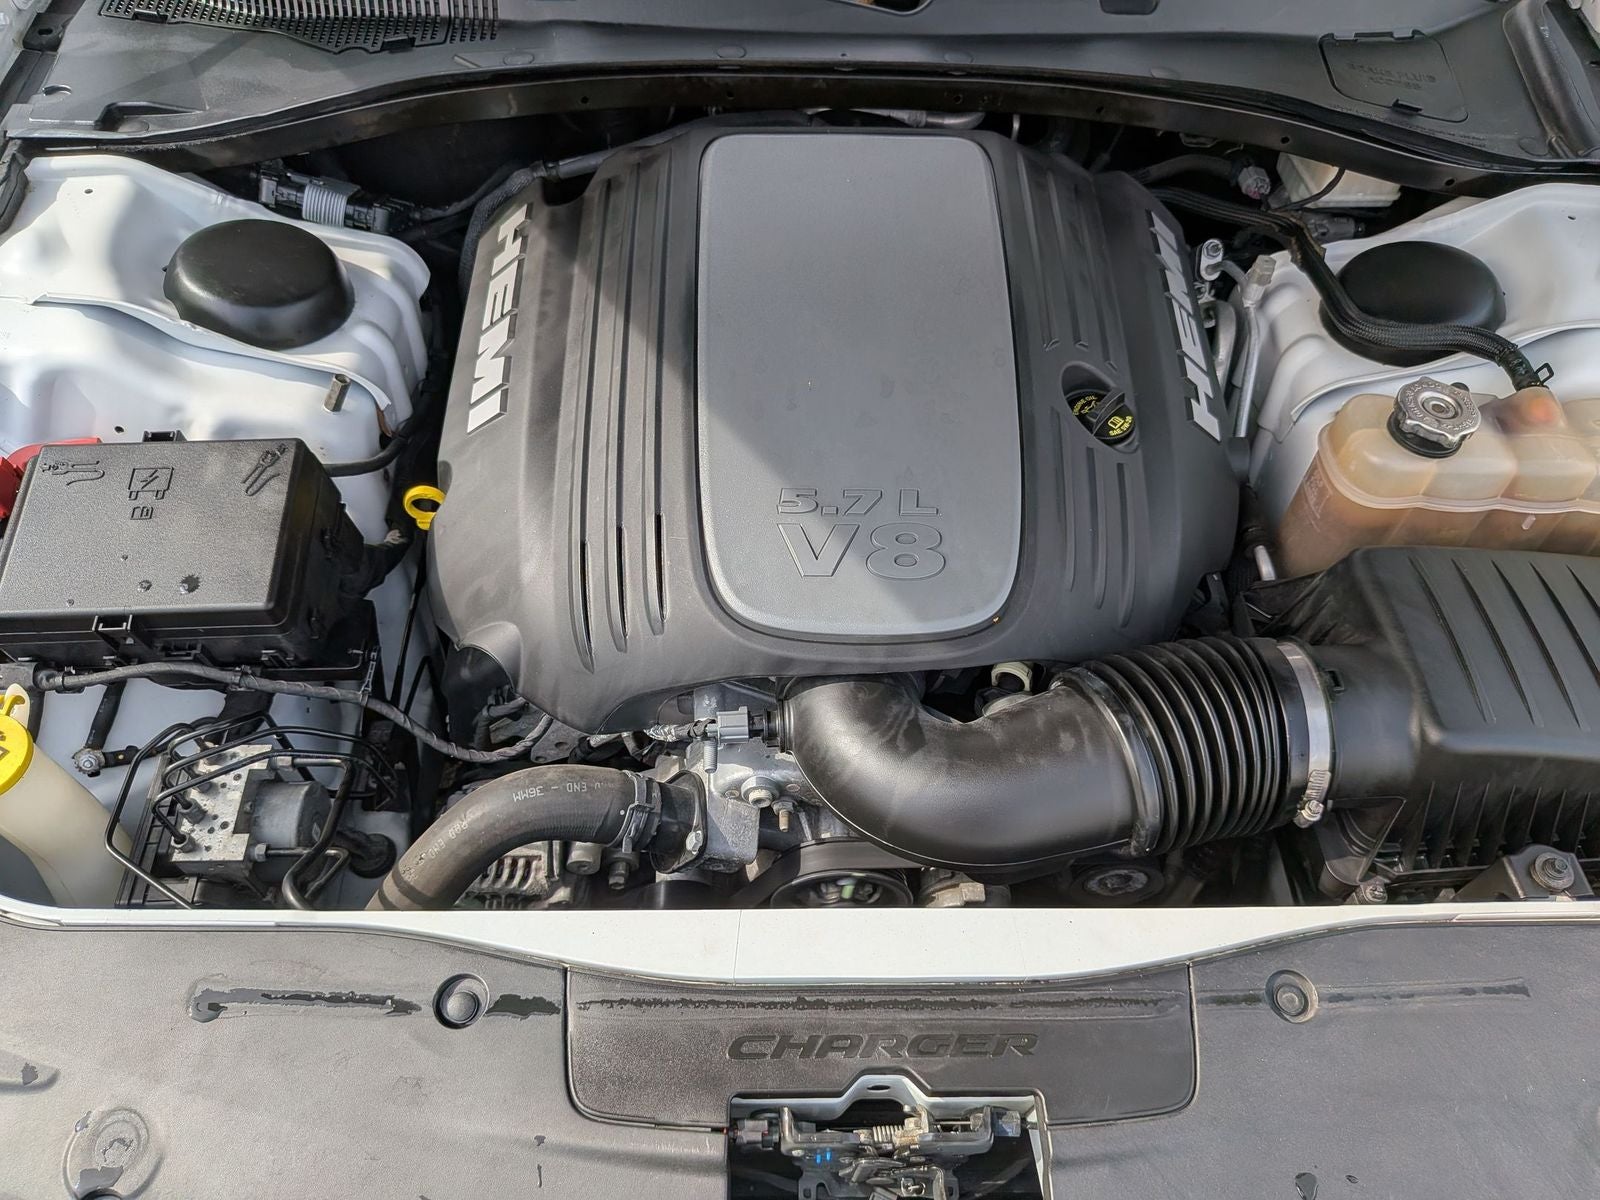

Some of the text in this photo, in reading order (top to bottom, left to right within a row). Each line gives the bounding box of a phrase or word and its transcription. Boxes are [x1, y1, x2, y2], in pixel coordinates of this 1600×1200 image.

[467, 203, 530, 435] HEMI
[1150, 210, 1222, 442] HEMI
[1109, 428, 1123, 436] SAE
[777, 522, 946, 581] V8
[512, 785, 545, 802] 36MM
[566, 782, 588, 793] END
[726, 1033, 1039, 1060] CHARGER
